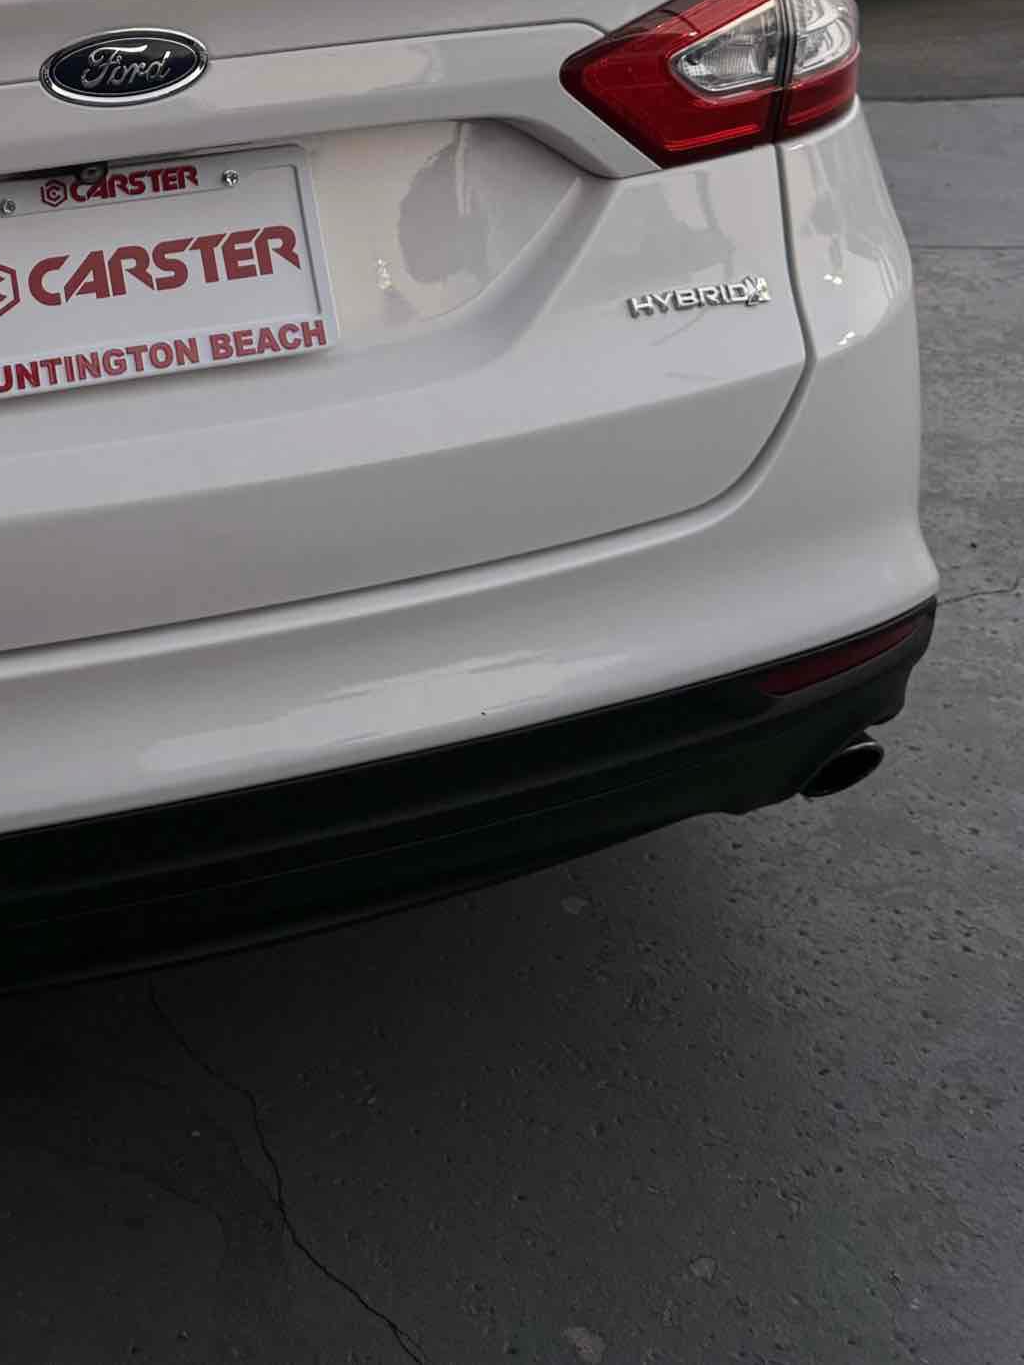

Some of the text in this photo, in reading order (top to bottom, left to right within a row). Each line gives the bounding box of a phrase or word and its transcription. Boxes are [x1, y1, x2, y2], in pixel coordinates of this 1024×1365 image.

[81, 44, 171, 87] Ford
[28, 225, 301, 307] CARSTER
[627, 282, 749, 318] HYBRID
[209, 319, 327, 360] BEACH
